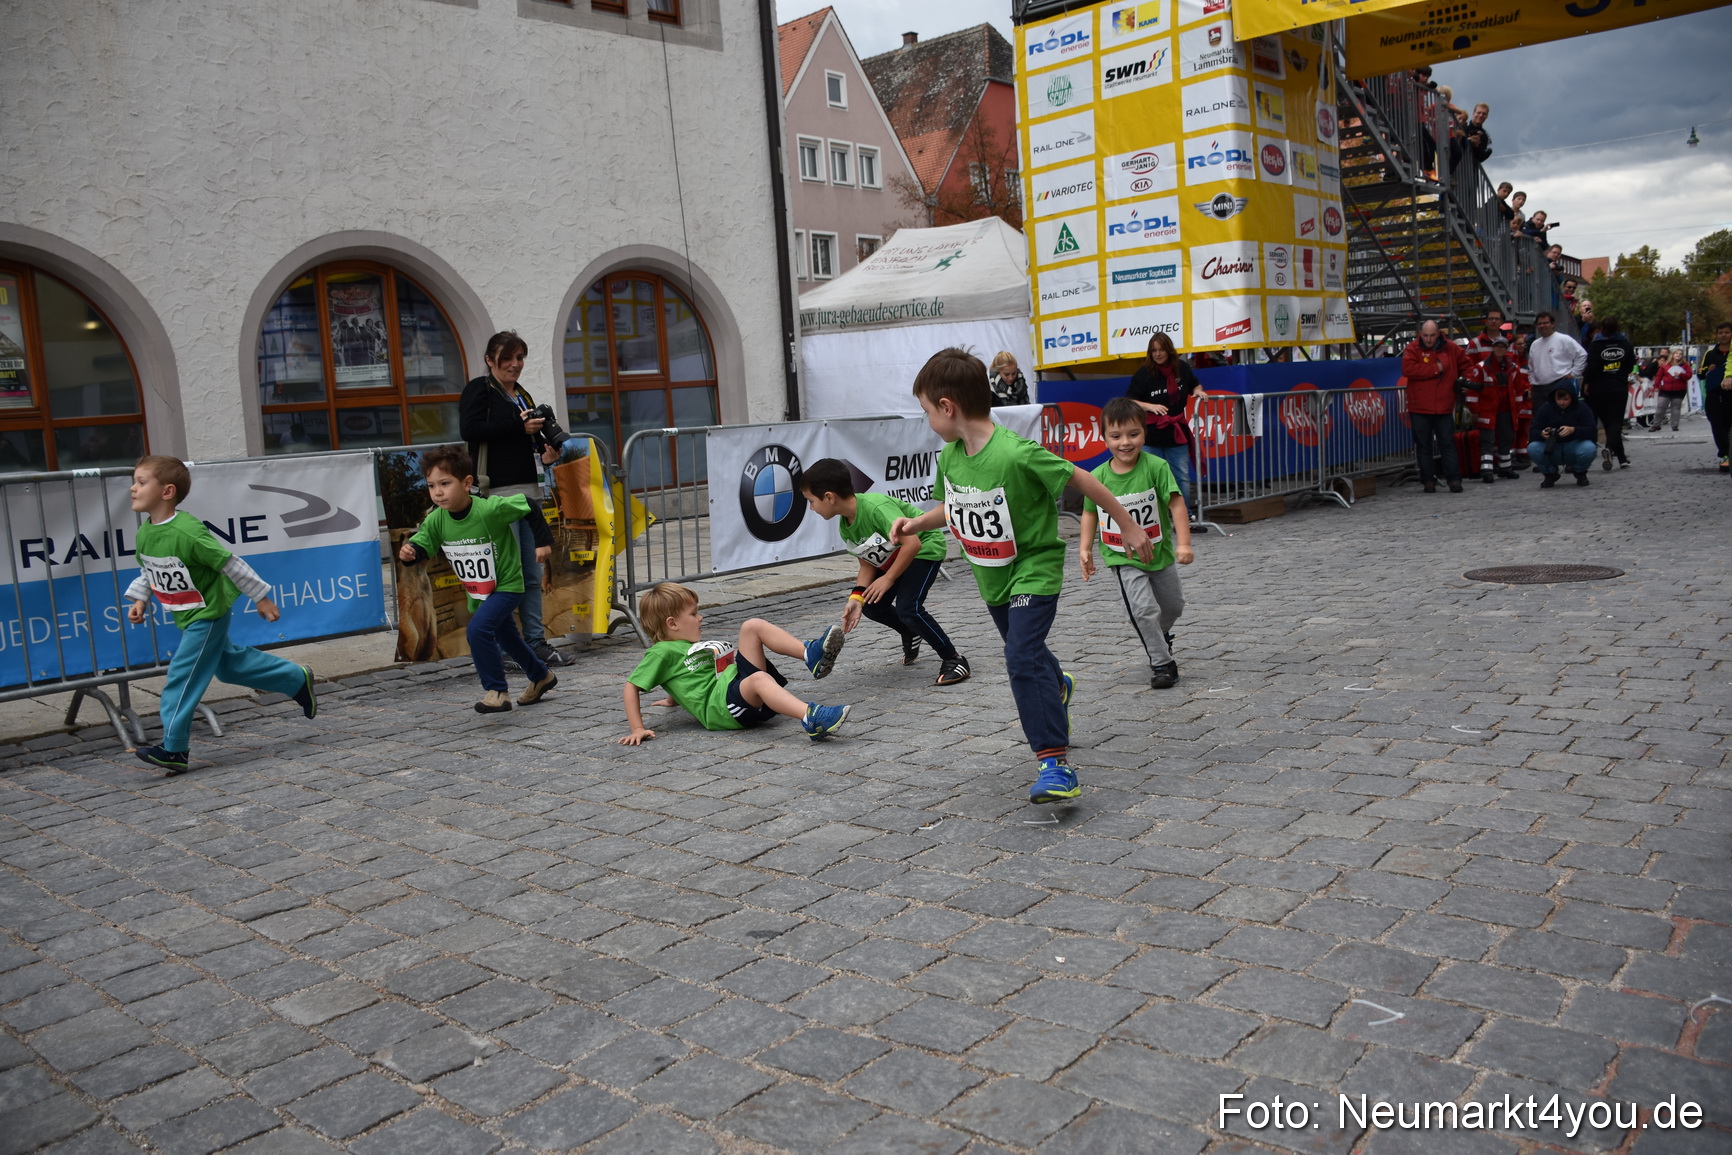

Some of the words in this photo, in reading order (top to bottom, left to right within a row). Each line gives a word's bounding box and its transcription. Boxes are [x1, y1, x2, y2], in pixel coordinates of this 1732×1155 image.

[1379, 21, 1454, 47] Neumarkter
[1457, 9, 1520, 32] Stadtlauf
[1028, 28, 1090, 56] RÖDL
[1060, 41, 1090, 55] energie
[1199, 47, 1236, 60] Neumarkter
[1104, 60, 1146, 83] swn
[1104, 78, 1132, 90] stadtwerke
[1133, 71, 1158, 82] neumarkt
[1121, 157, 1151, 168] GERHART
[1187, 140, 1252, 170] RÖDL
[1263, 151, 1283, 168] Hervis
[1226, 161, 1253, 172] energie
[1051, 181, 1093, 199] VARIOTEC
[1134, 181, 1149, 190] KIA
[1213, 202, 1233, 211] MINI
[1109, 209, 1177, 236] RÖDL
[1144, 227, 1177, 239] energie
[1115, 271, 1148, 282] Neumarkter
[1149, 268, 1174, 278] Tagblatt
[1201, 256, 1254, 280] Charivari
[800, 296, 945, 329] ww.jura-gebaeudeservice.de
[1044, 324, 1098, 350] RÖDL
[1129, 322, 1180, 336] VARIOTEC
[1071, 342, 1098, 353] energie
[1040, 415, 1106, 450] Hervi
[744, 447, 800, 480] BMW
[885, 451, 932, 482] BMW
[1103, 505, 1155, 530] 702
[20, 514, 269, 568] RAILNE
[148, 567, 189, 592] 7423
[448, 558, 490, 579] 030
